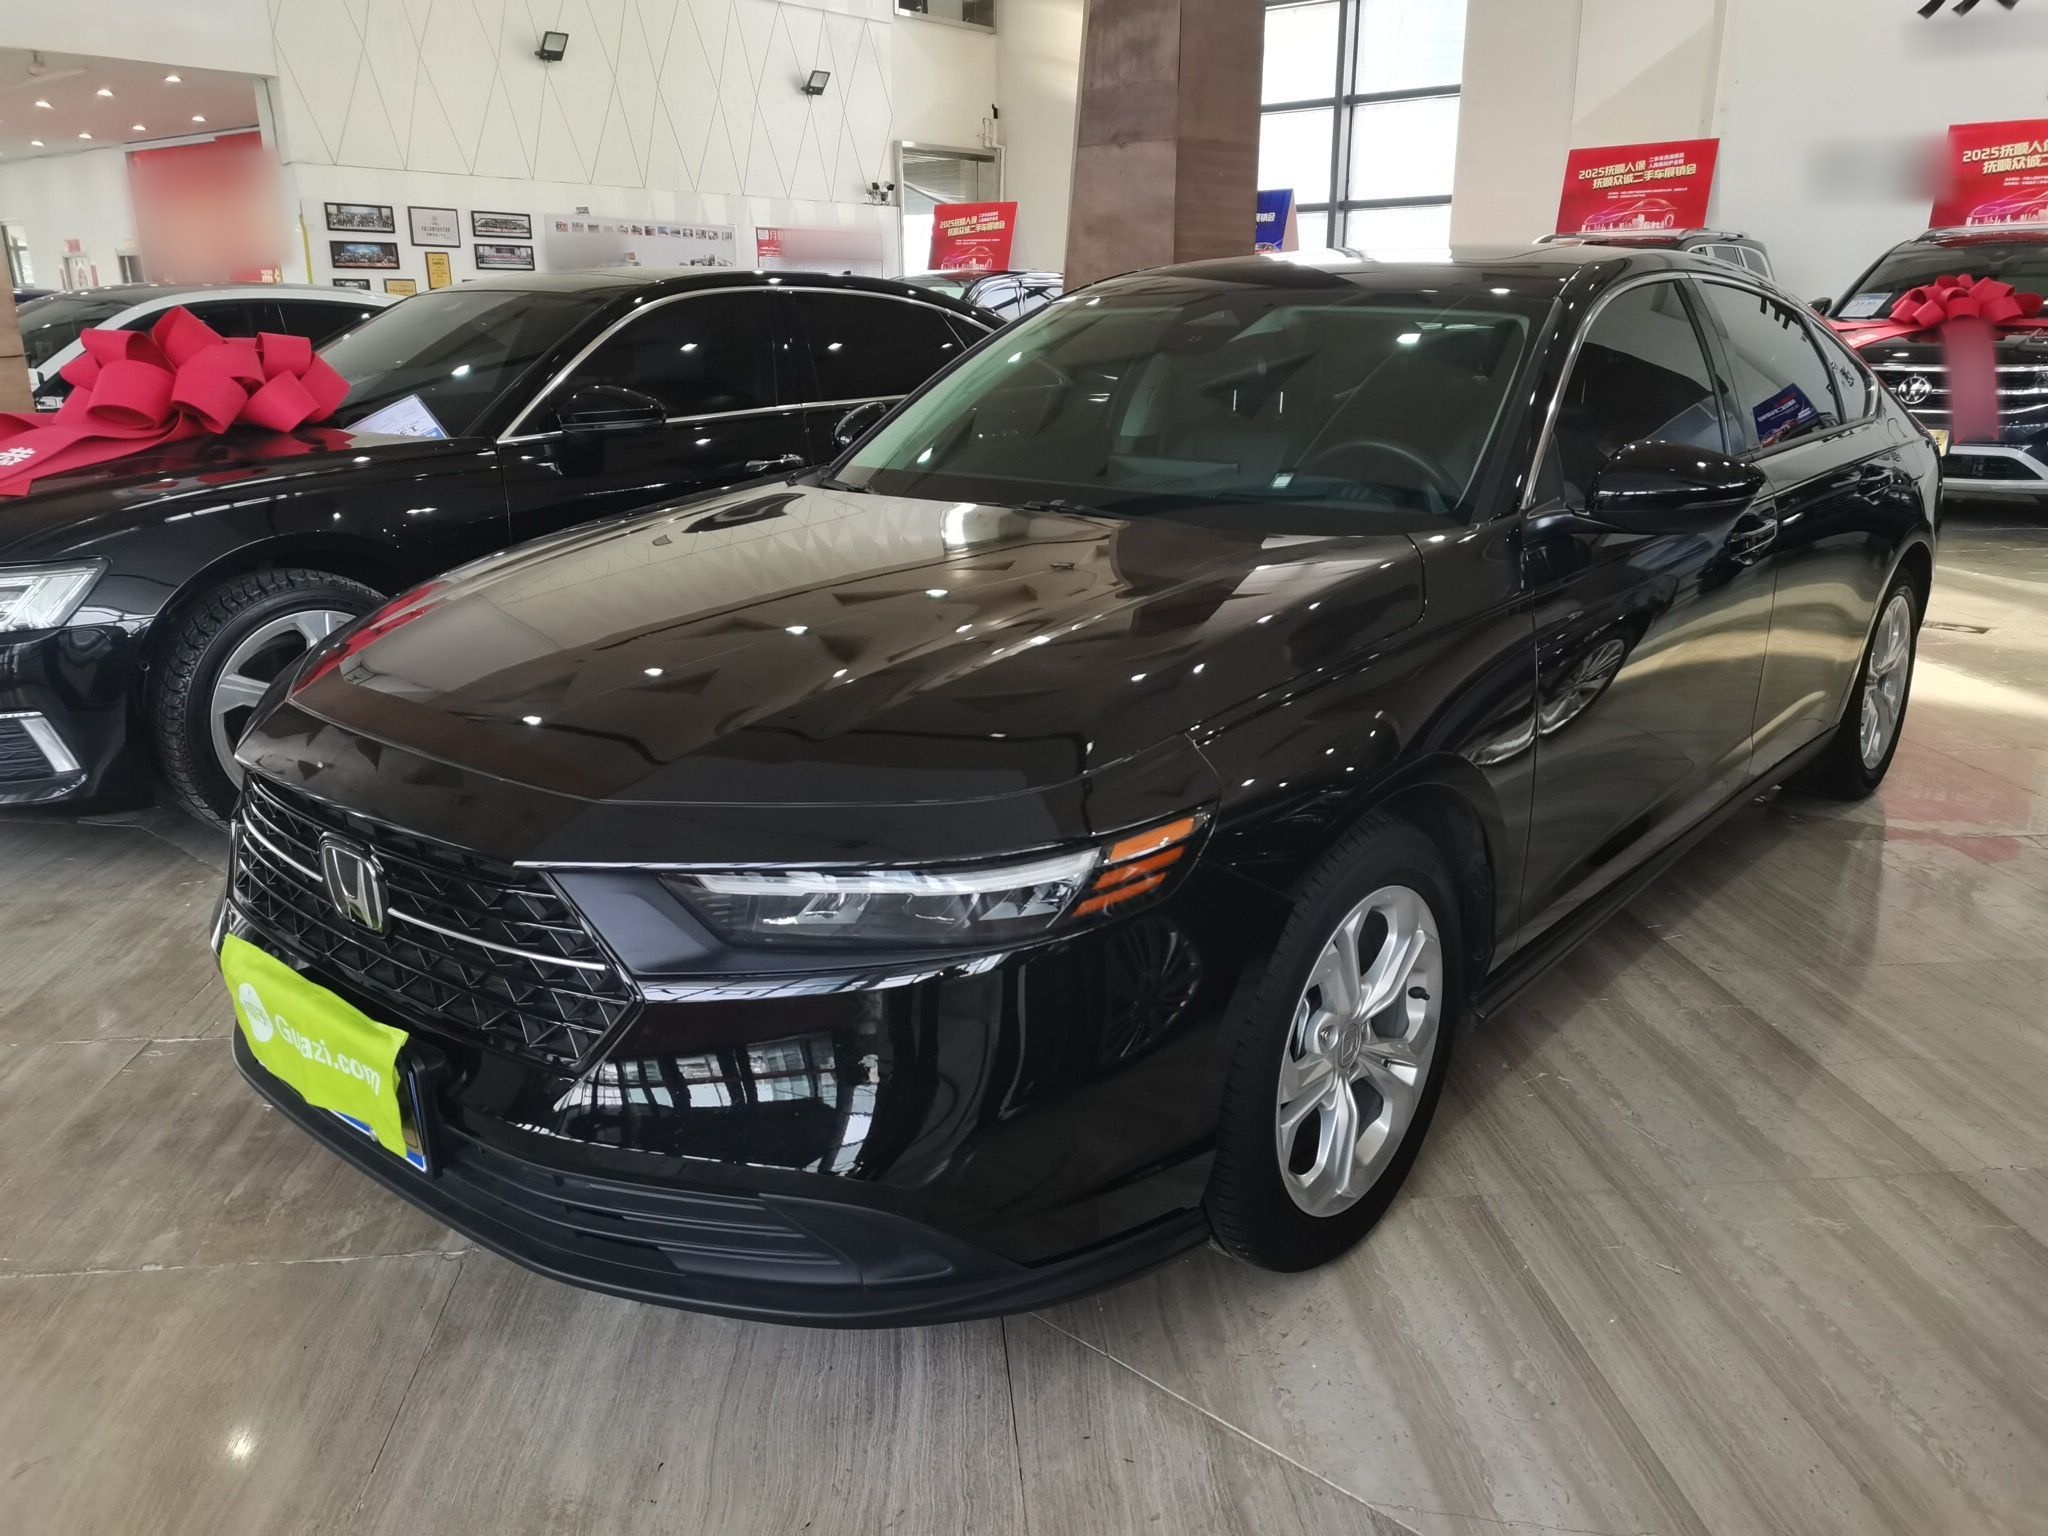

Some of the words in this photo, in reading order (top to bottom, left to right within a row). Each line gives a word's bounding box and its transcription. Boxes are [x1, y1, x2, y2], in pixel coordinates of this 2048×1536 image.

[1578, 160, 1646, 180] 2025抚顺人保
[1592, 163, 1697, 190] 抚顺众诚二手车展销会
[274, 1013, 382, 1097] Guazi.com
